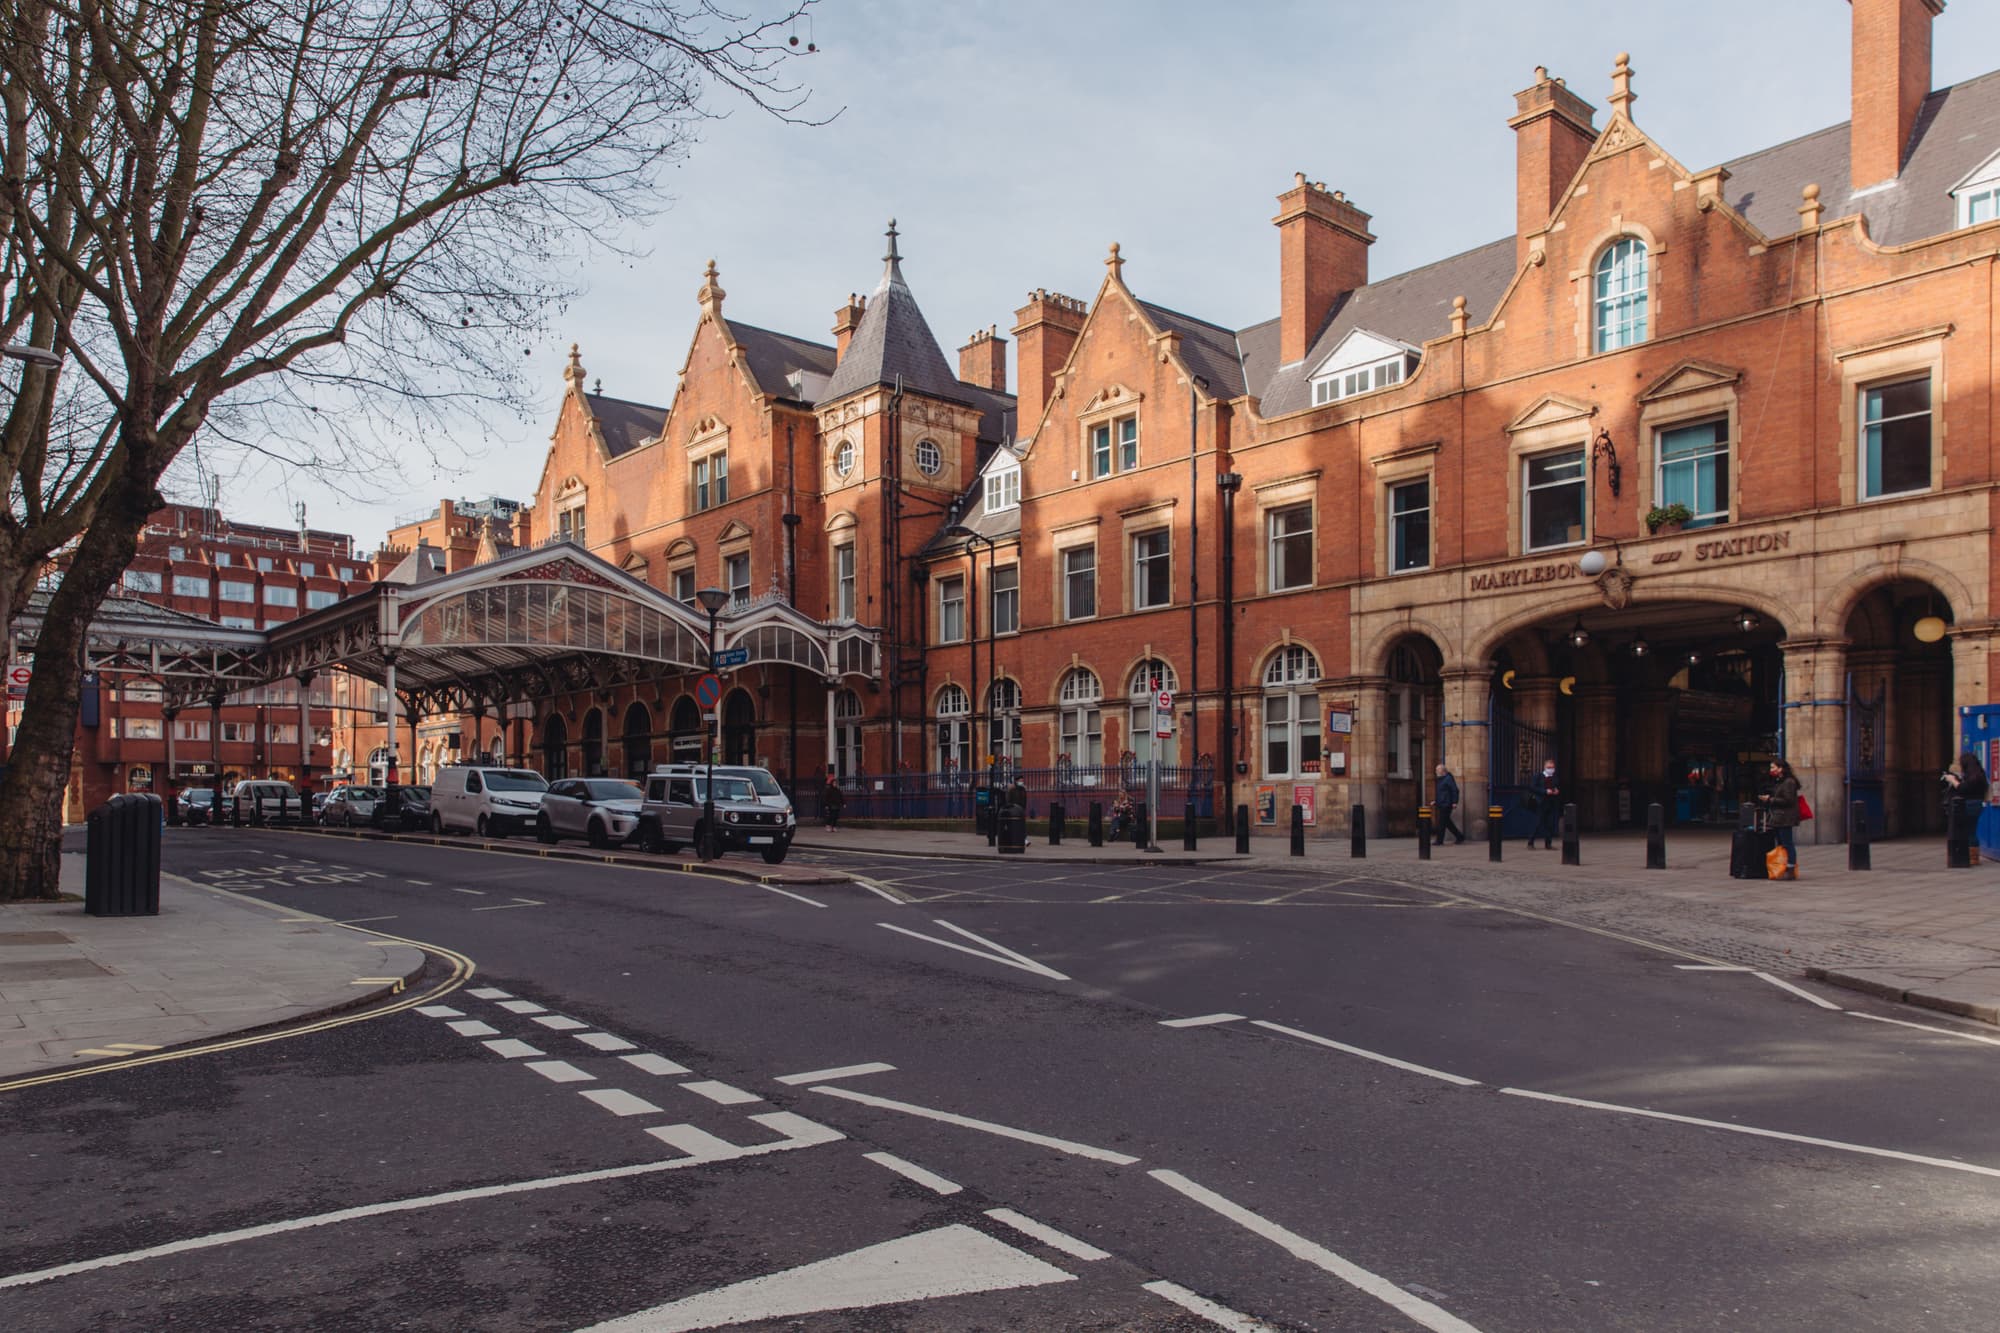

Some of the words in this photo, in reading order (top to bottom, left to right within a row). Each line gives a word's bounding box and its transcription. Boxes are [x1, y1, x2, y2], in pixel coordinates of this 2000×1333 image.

[1470, 562, 1585, 592] MARYLEBON
[1695, 530, 1791, 561] STATION
[199, 865, 322, 879] BUS
[212, 872, 368, 891] STOP
